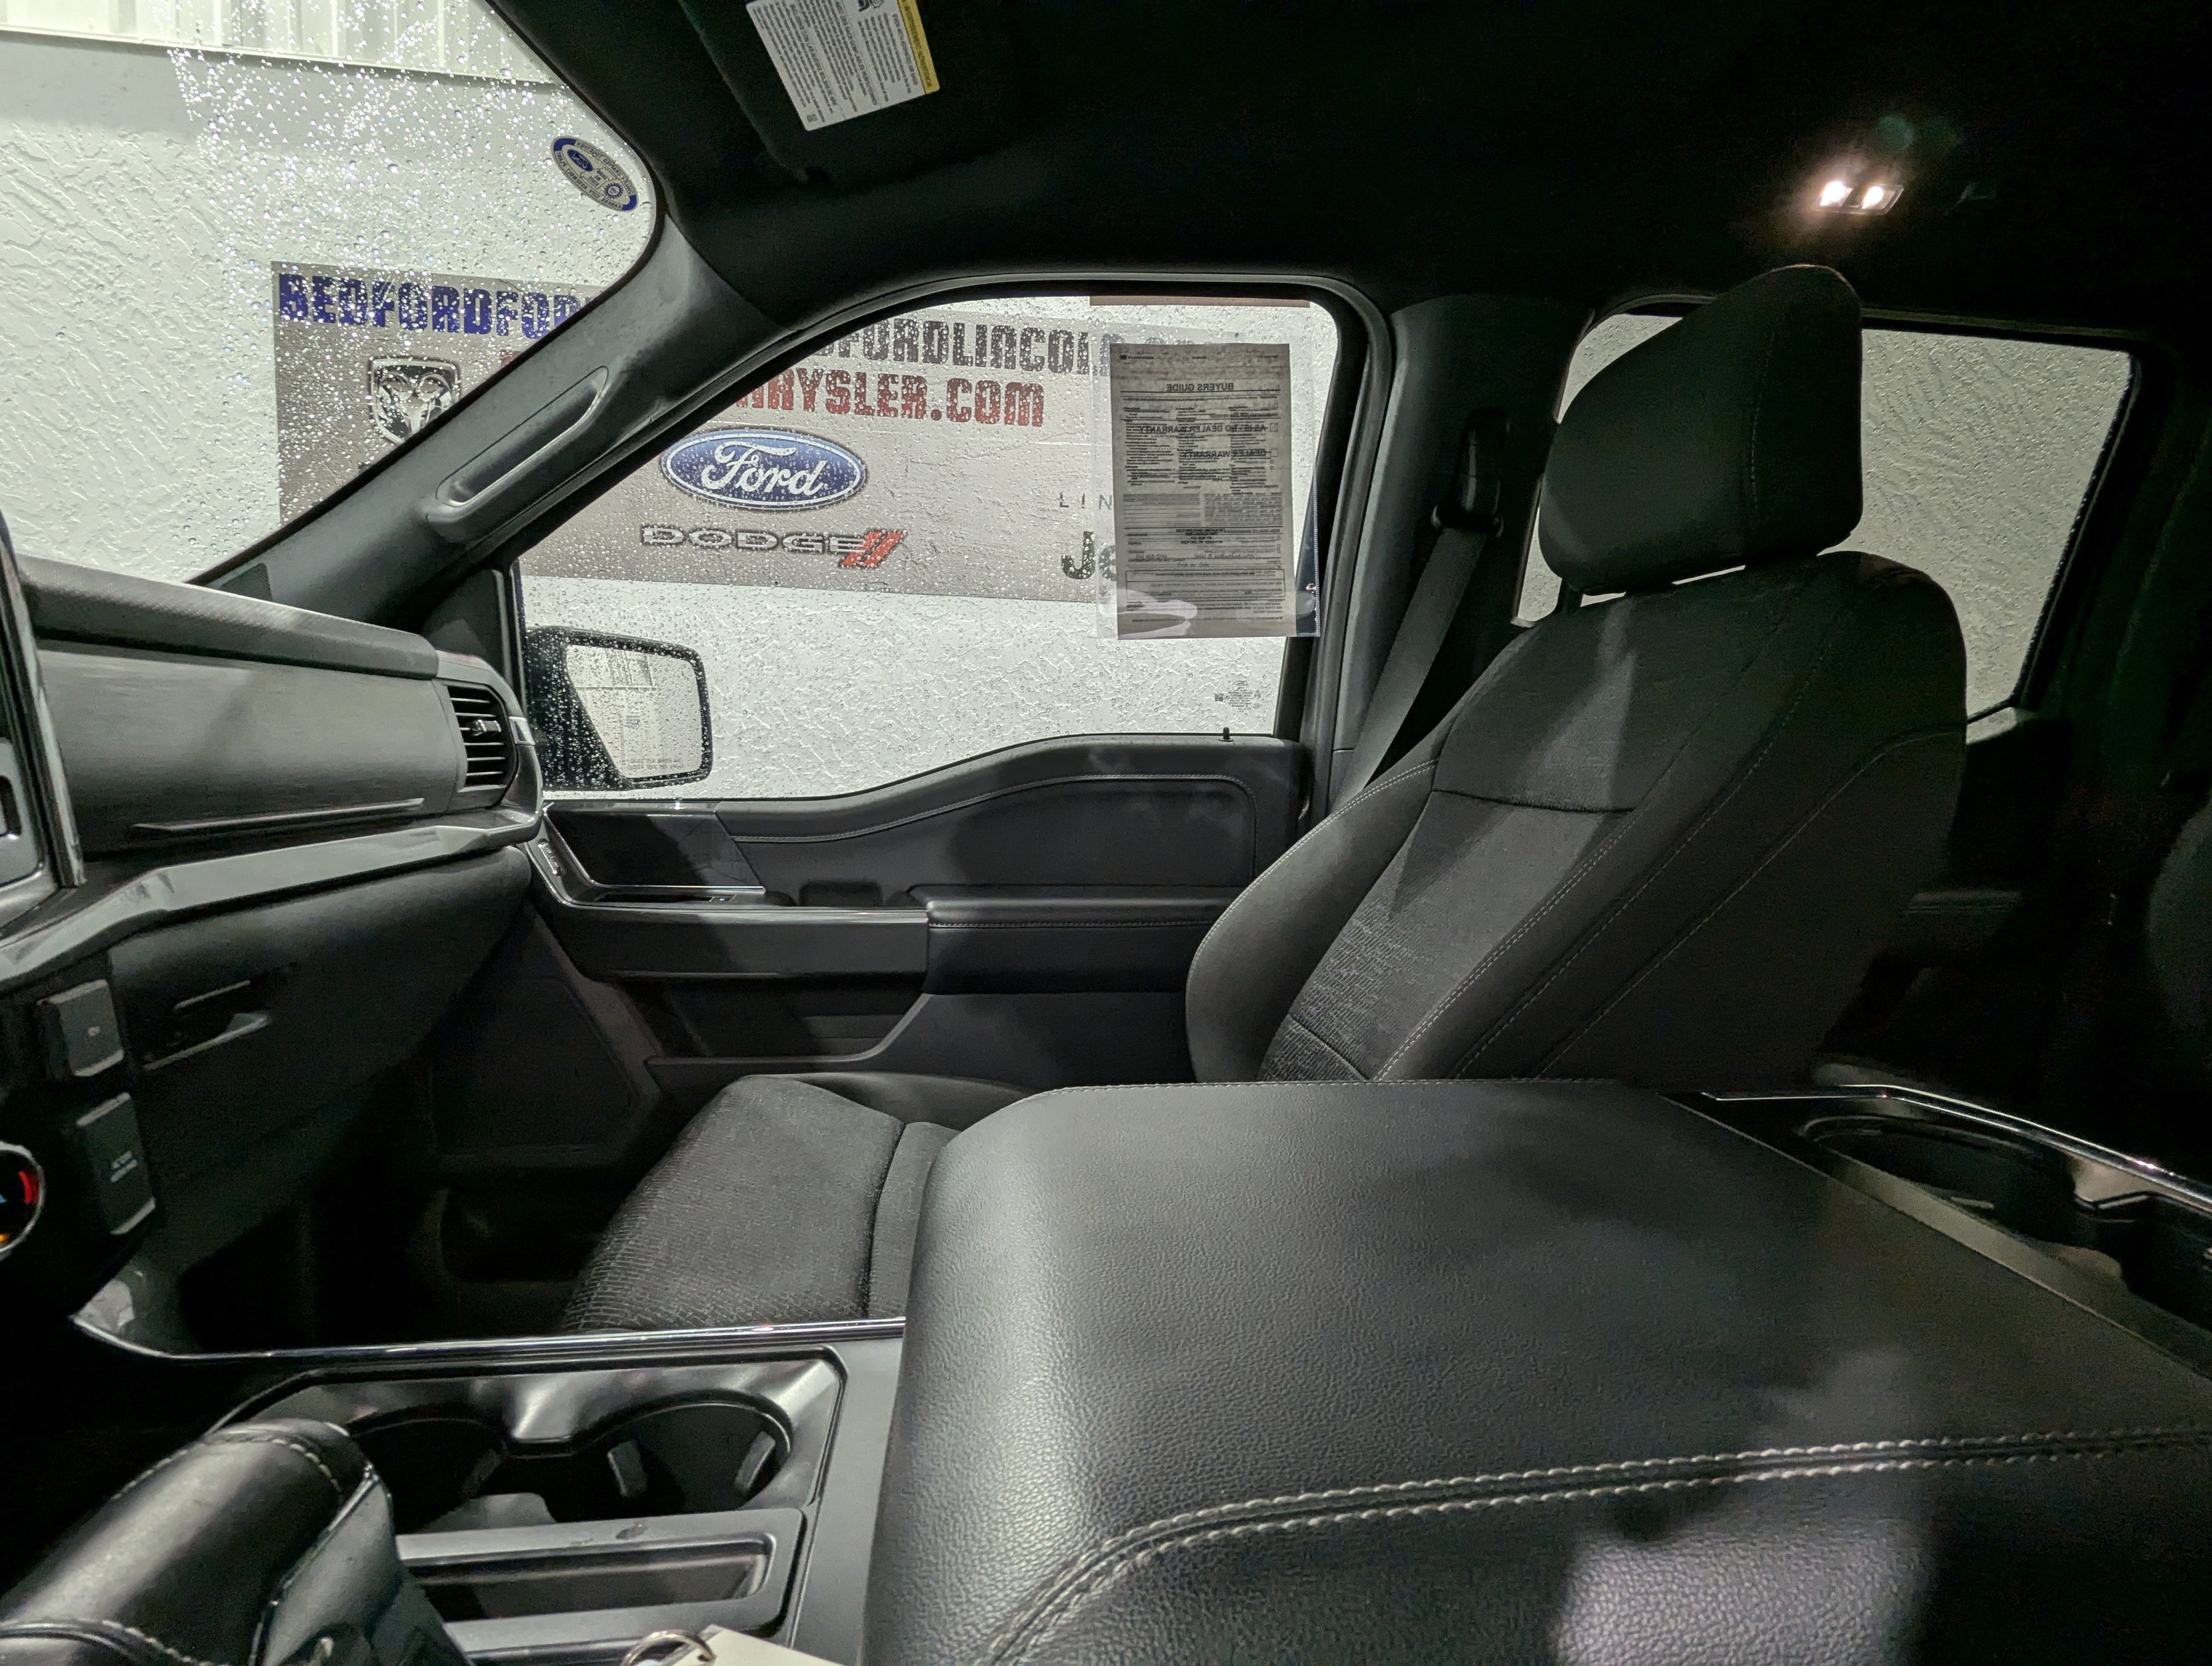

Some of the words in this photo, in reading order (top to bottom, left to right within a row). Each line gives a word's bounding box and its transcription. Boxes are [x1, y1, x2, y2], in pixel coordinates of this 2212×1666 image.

[279, 273, 594, 339] BEDFORDFOR
[702, 440, 827, 496] Ford
[641, 526, 866, 555] DODGE
